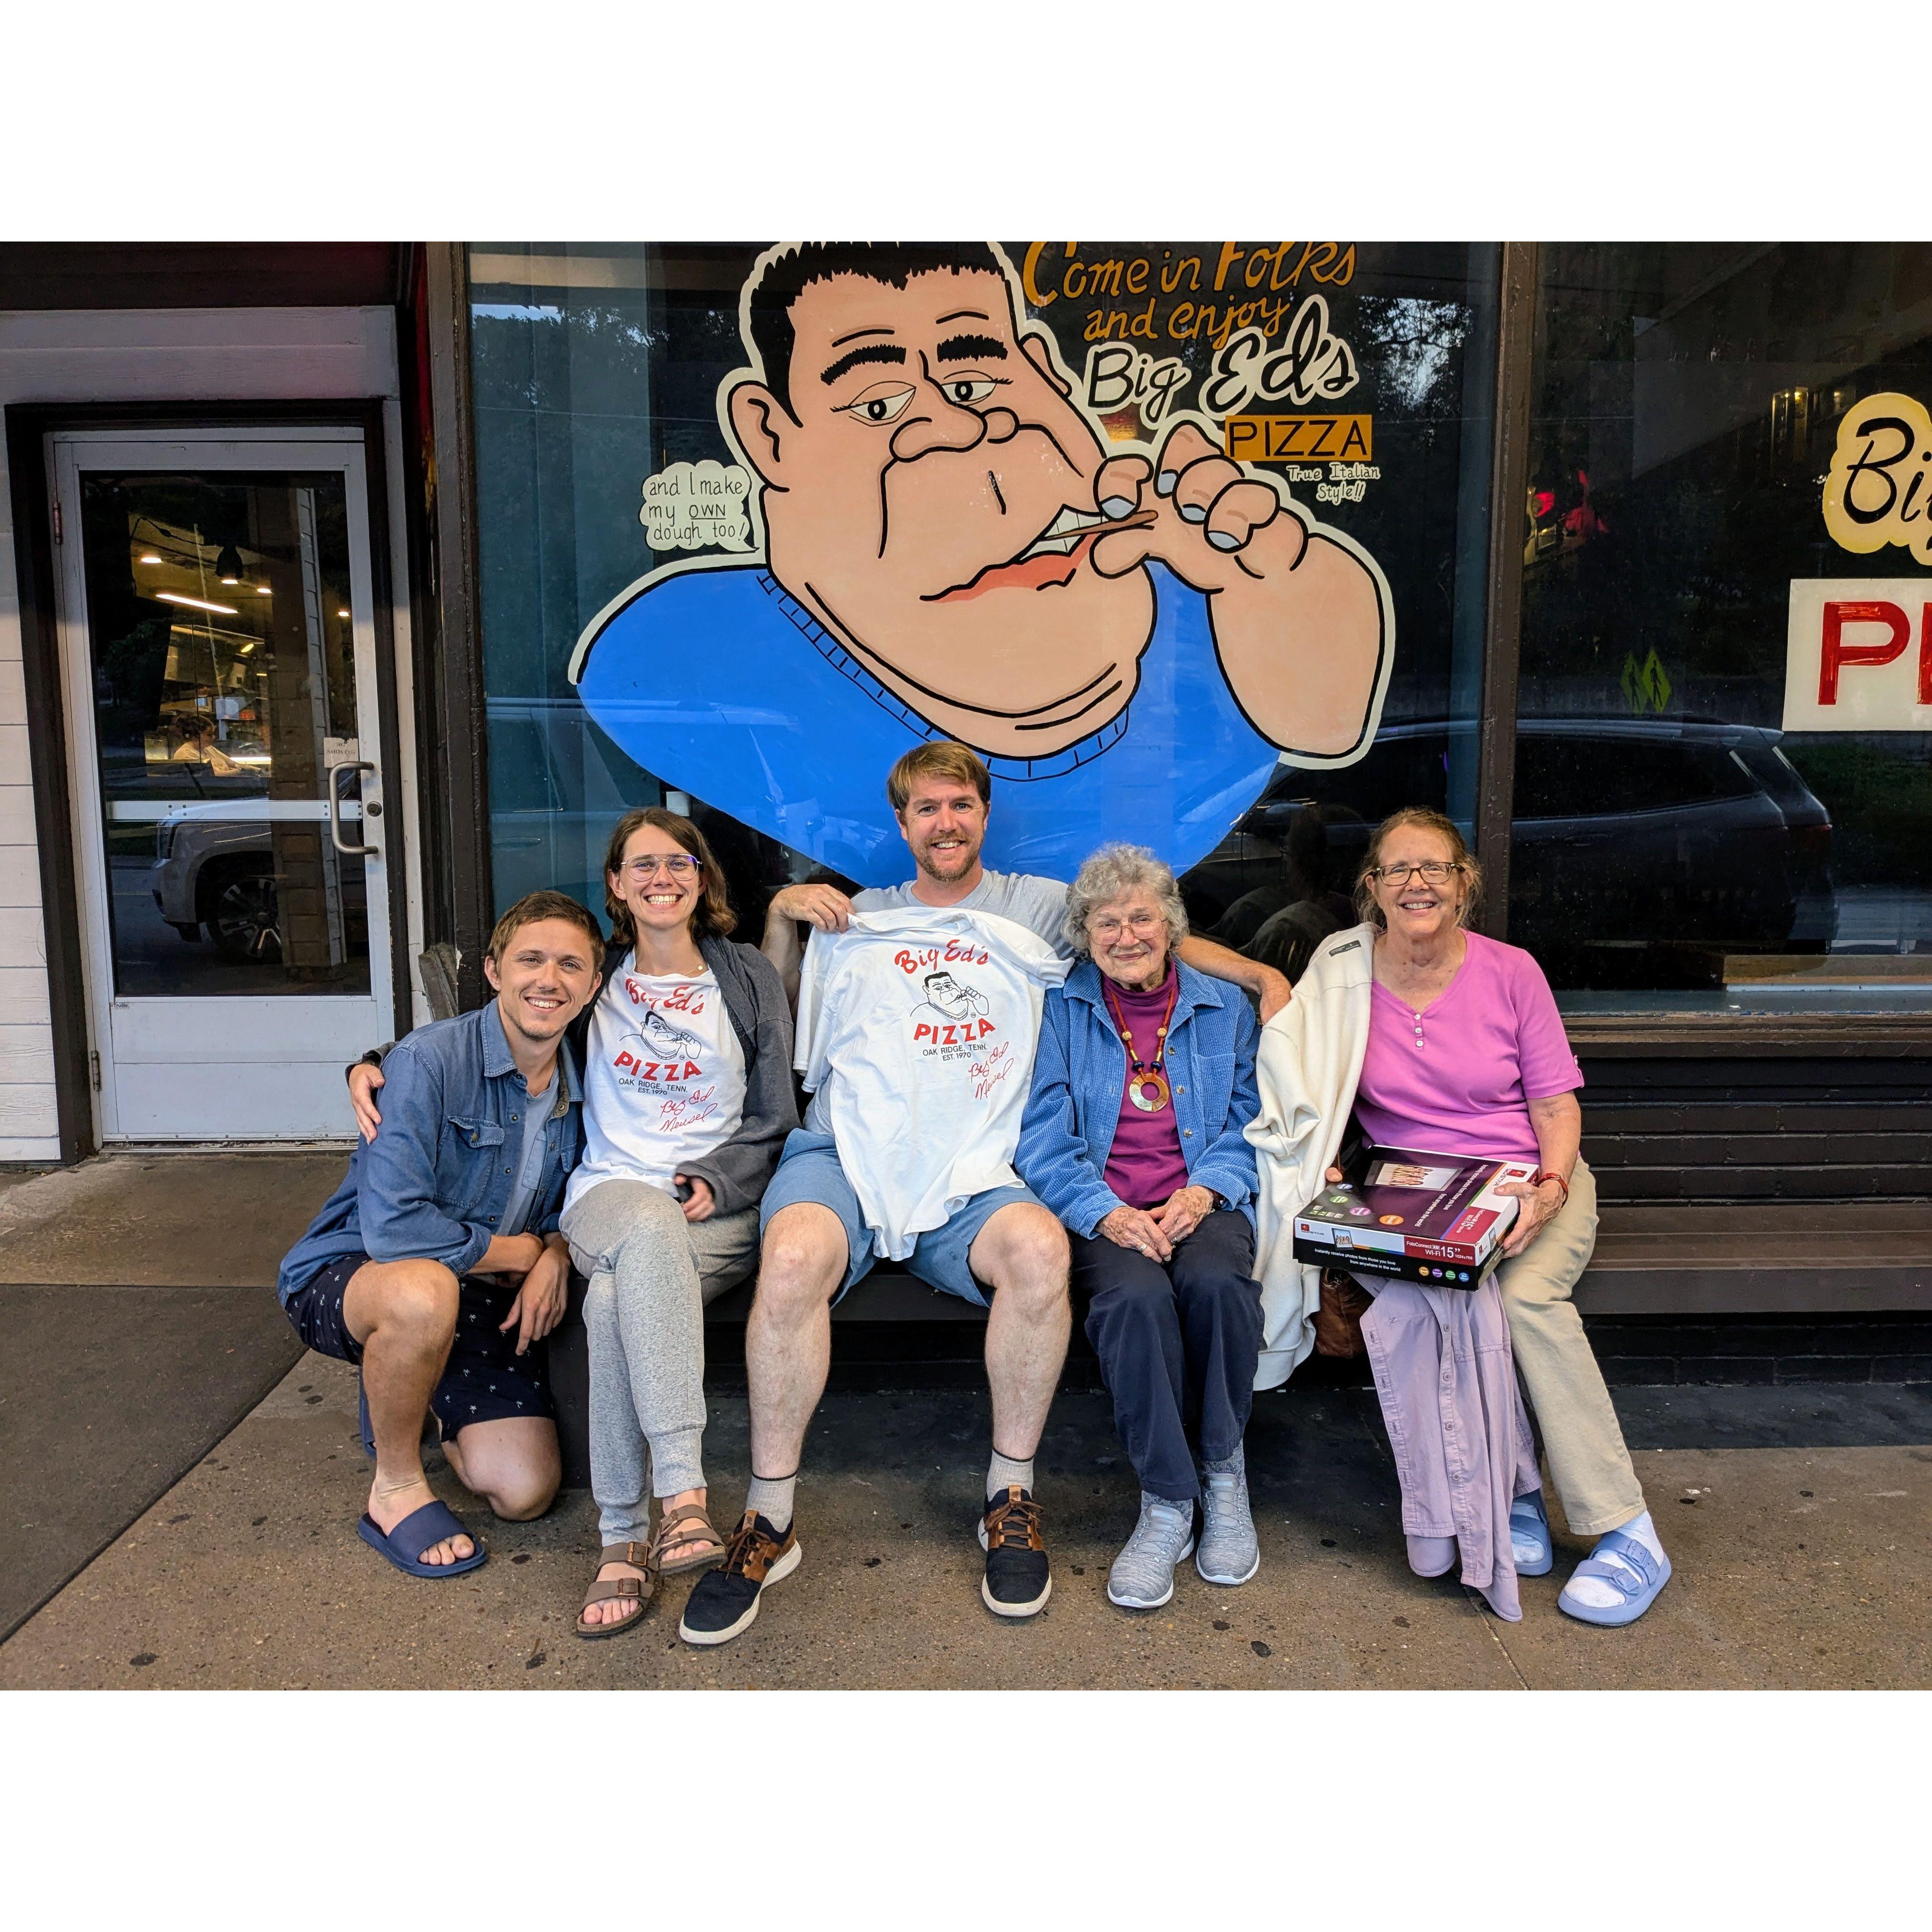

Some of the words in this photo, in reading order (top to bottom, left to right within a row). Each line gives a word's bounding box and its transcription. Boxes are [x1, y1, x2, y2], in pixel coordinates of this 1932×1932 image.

[1023, 242, 1150, 307] Come
[1161, 251, 1201, 292] in
[1214, 242, 1357, 291] Folks
[1083, 297, 1157, 341] and
[1168, 295, 1290, 350] enjoy
[1088, 348, 1186, 423] Big
[1206, 300, 1354, 413] Ed's
[1229, 420, 1368, 457] PIZZA
[650, 475, 680, 496] and
[701, 475, 743, 494] make
[1288, 465, 1322, 482] True
[1330, 462, 1380, 481] Italian
[1843, 417, 1932, 551] Bi
[1317, 483, 1365, 504] Style!!
[649, 505, 675, 526] my
[654, 521, 702, 545] dough
[713, 521, 745, 541] too!
[895, 949, 939, 974] Big
[944, 939, 988, 965] Ed's
[664, 986, 704, 1014] Ed's
[914, 1018, 996, 1045] PIZZA
[941, 1045, 966, 1054] RIDGE,
[613, 1051, 702, 1081] PIZZA
[638, 1081, 662, 1090] RIDGE,
[667, 1084, 688, 1092] TENN.
[1406, 1241, 1432, 1249] FotoConnect
